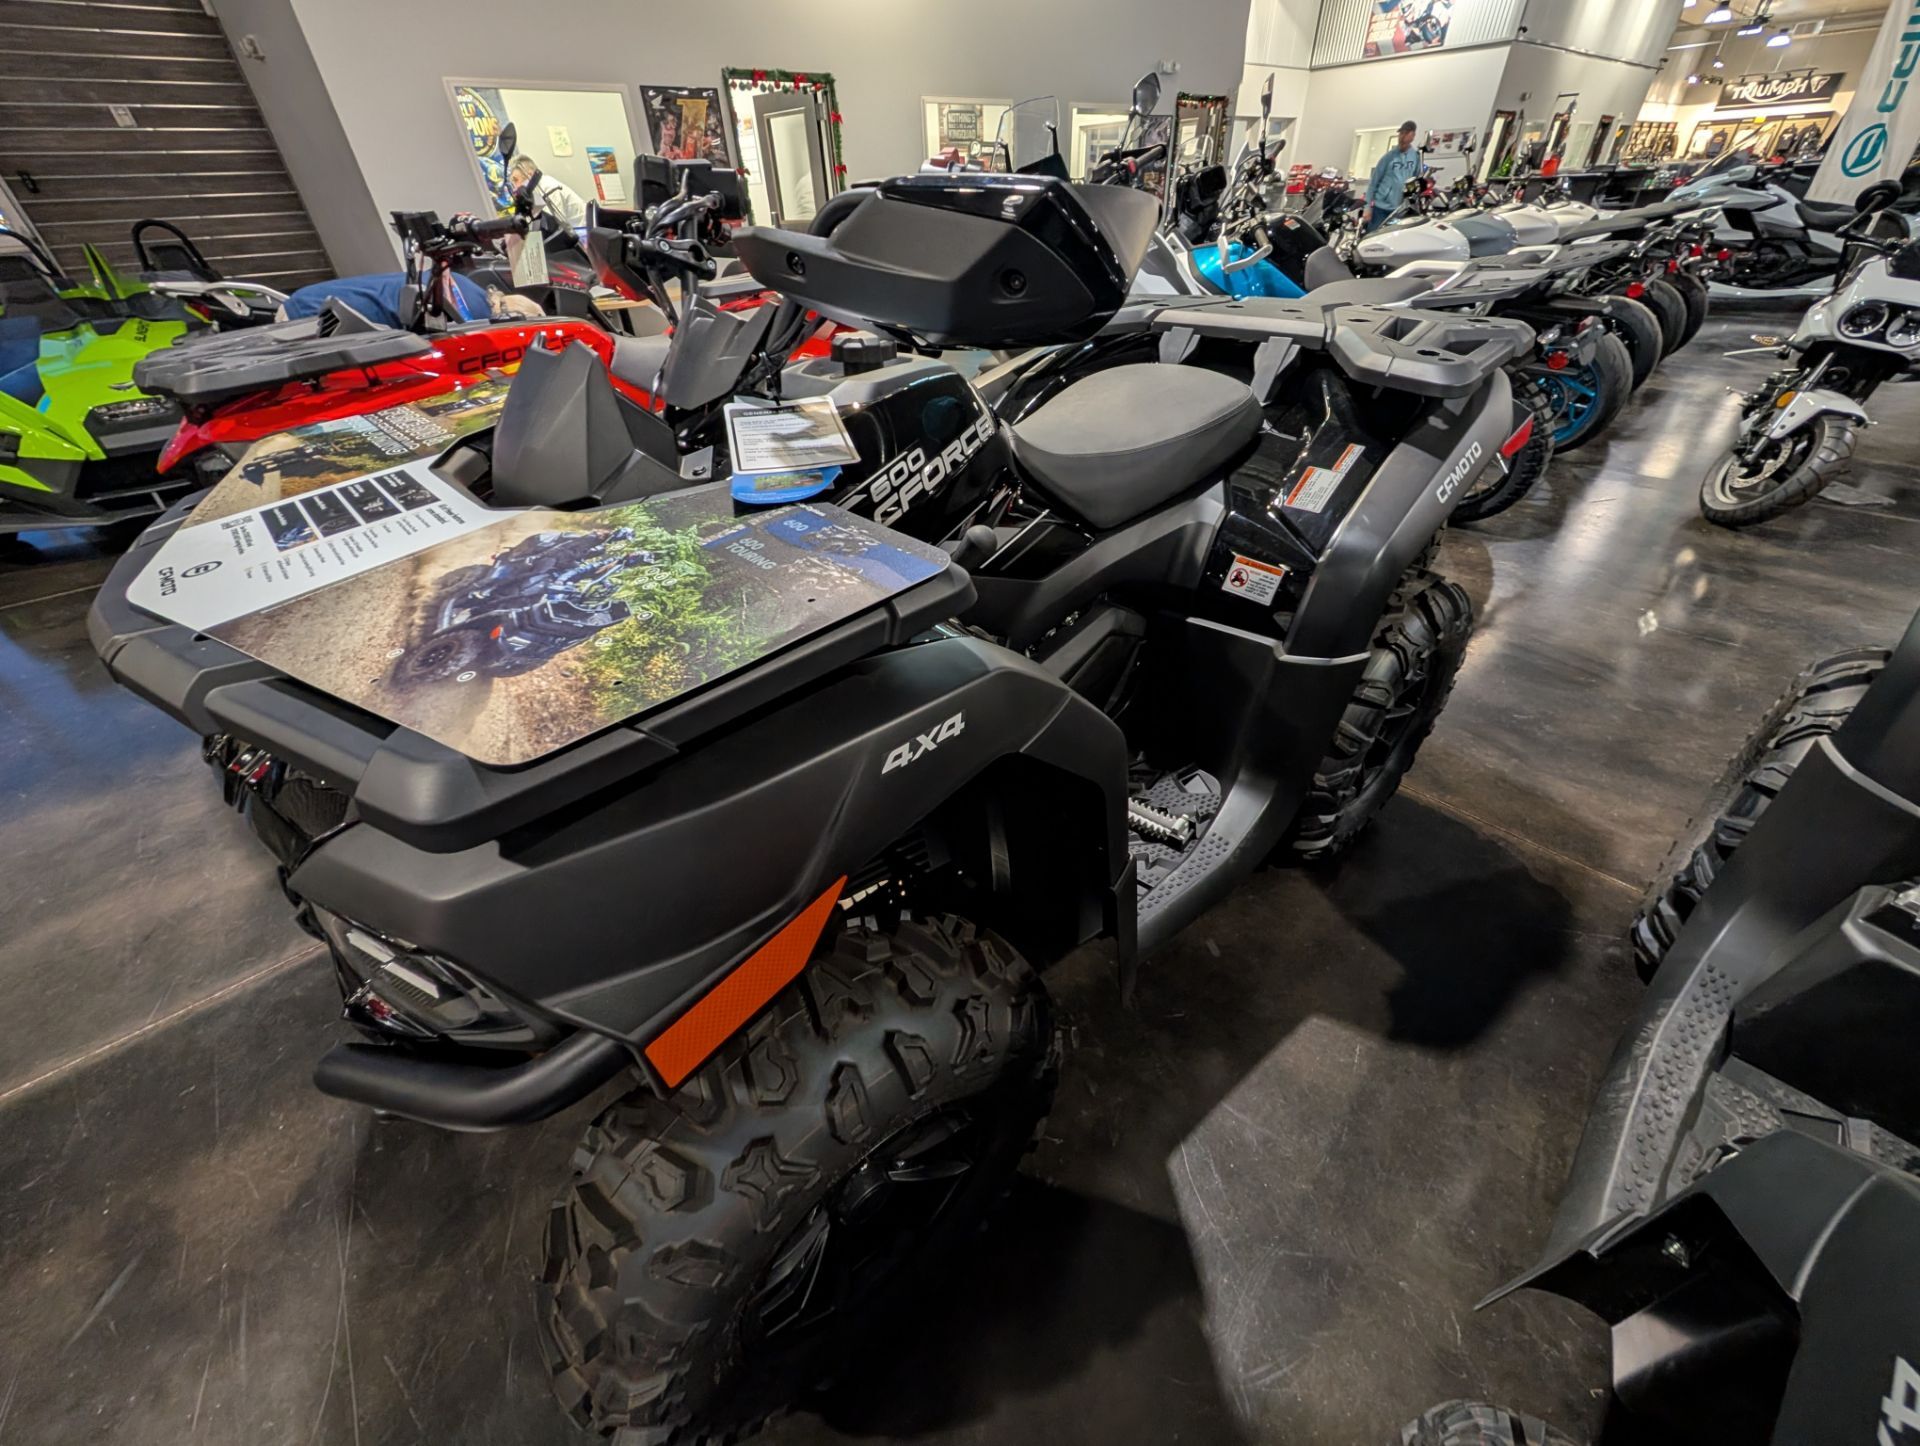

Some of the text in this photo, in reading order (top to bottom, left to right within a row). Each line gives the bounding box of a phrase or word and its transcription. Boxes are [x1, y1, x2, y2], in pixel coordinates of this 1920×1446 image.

[1729, 77, 1809, 103] TRIUMPH
[870, 447, 925, 503] 600
[873, 414, 994, 527] CFORCE
[1436, 441, 1482, 503] CFMOTO
[783, 519, 809, 532] 600
[725, 542, 777, 570] TOURING
[739, 537, 765, 551] 600
[158, 566, 177, 597] CFMOTO
[881, 712, 965, 775] 4X4
